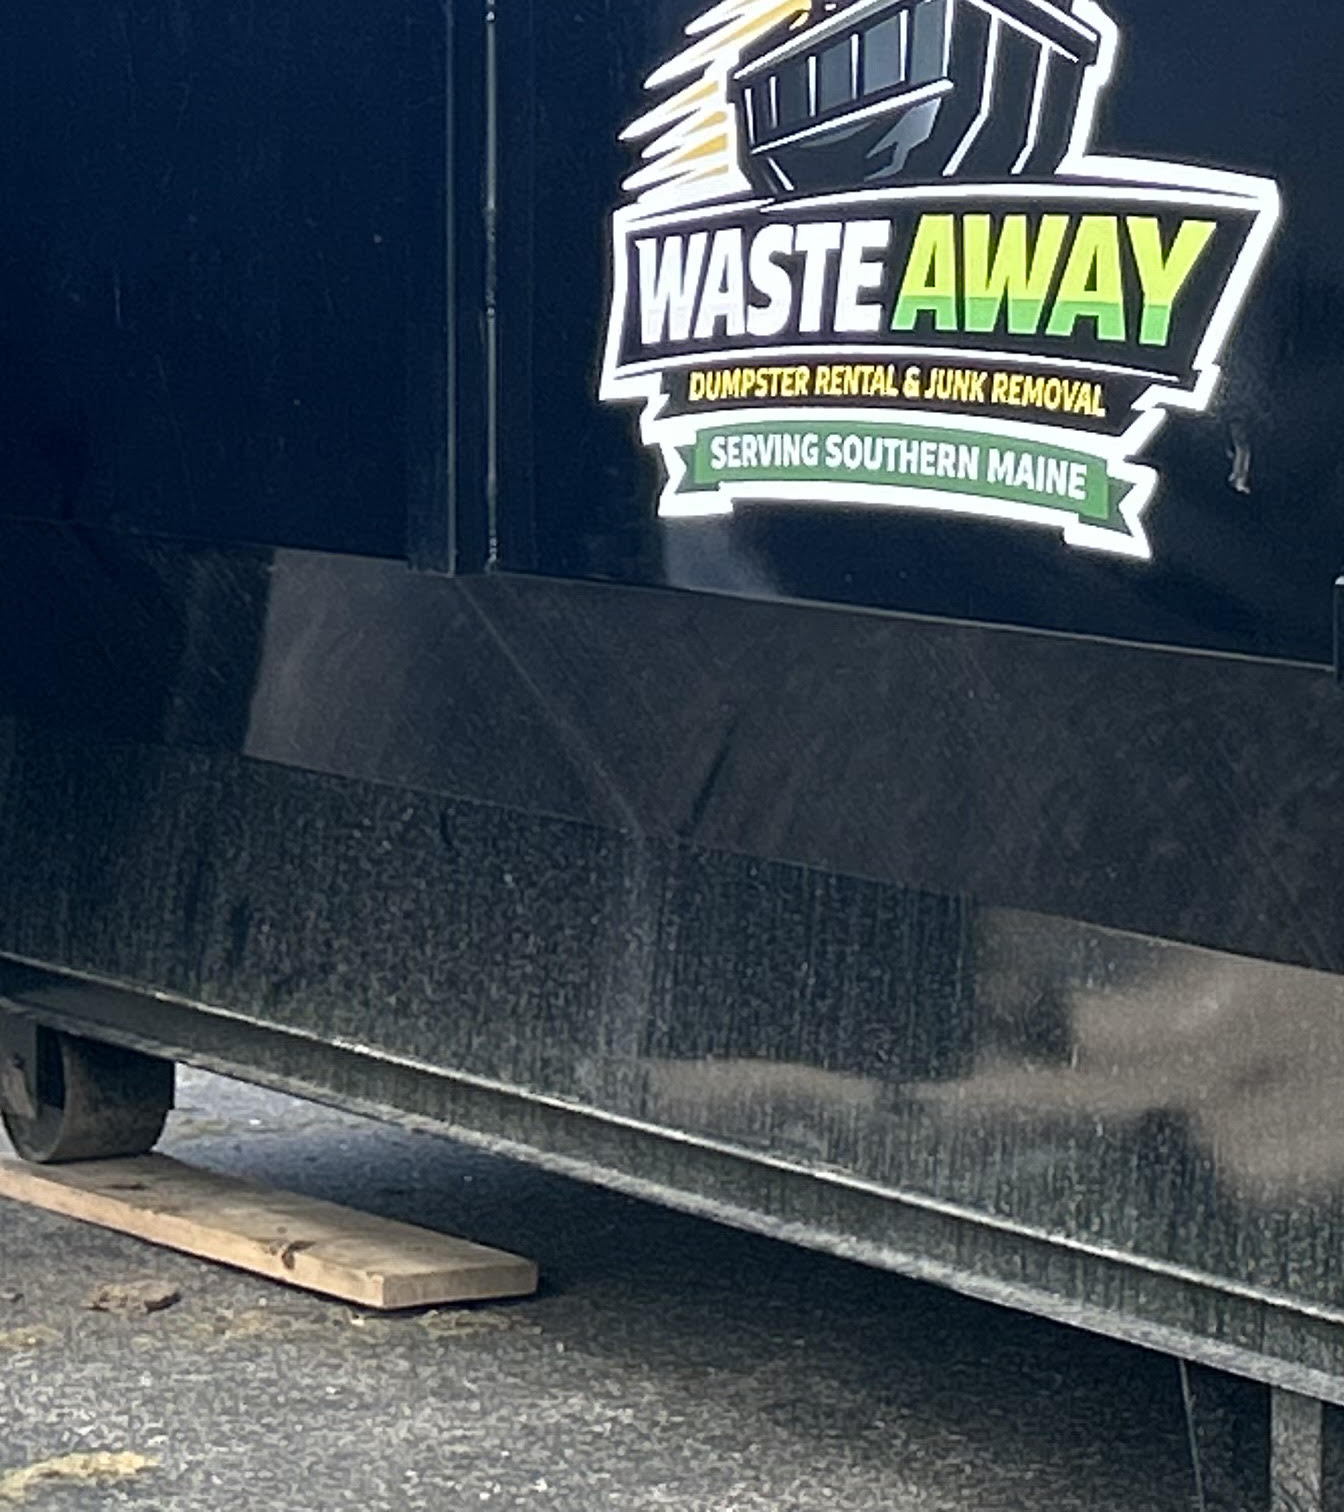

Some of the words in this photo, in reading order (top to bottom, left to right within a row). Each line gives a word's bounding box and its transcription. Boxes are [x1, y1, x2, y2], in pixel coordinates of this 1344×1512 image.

[635, 218, 892, 345] WASTE
[892, 213, 1217, 347] AWAY
[688, 366, 809, 402] DUMPSTER
[815, 364, 899, 399] RENTAL
[903, 366, 921, 399] &
[924, 367, 985, 403] JUNK
[991, 371, 1107, 418] REMOVAL
[709, 432, 819, 470] SERVING
[824, 434, 980, 481] SOUTHERN
[986, 448, 1088, 501] MAINE
